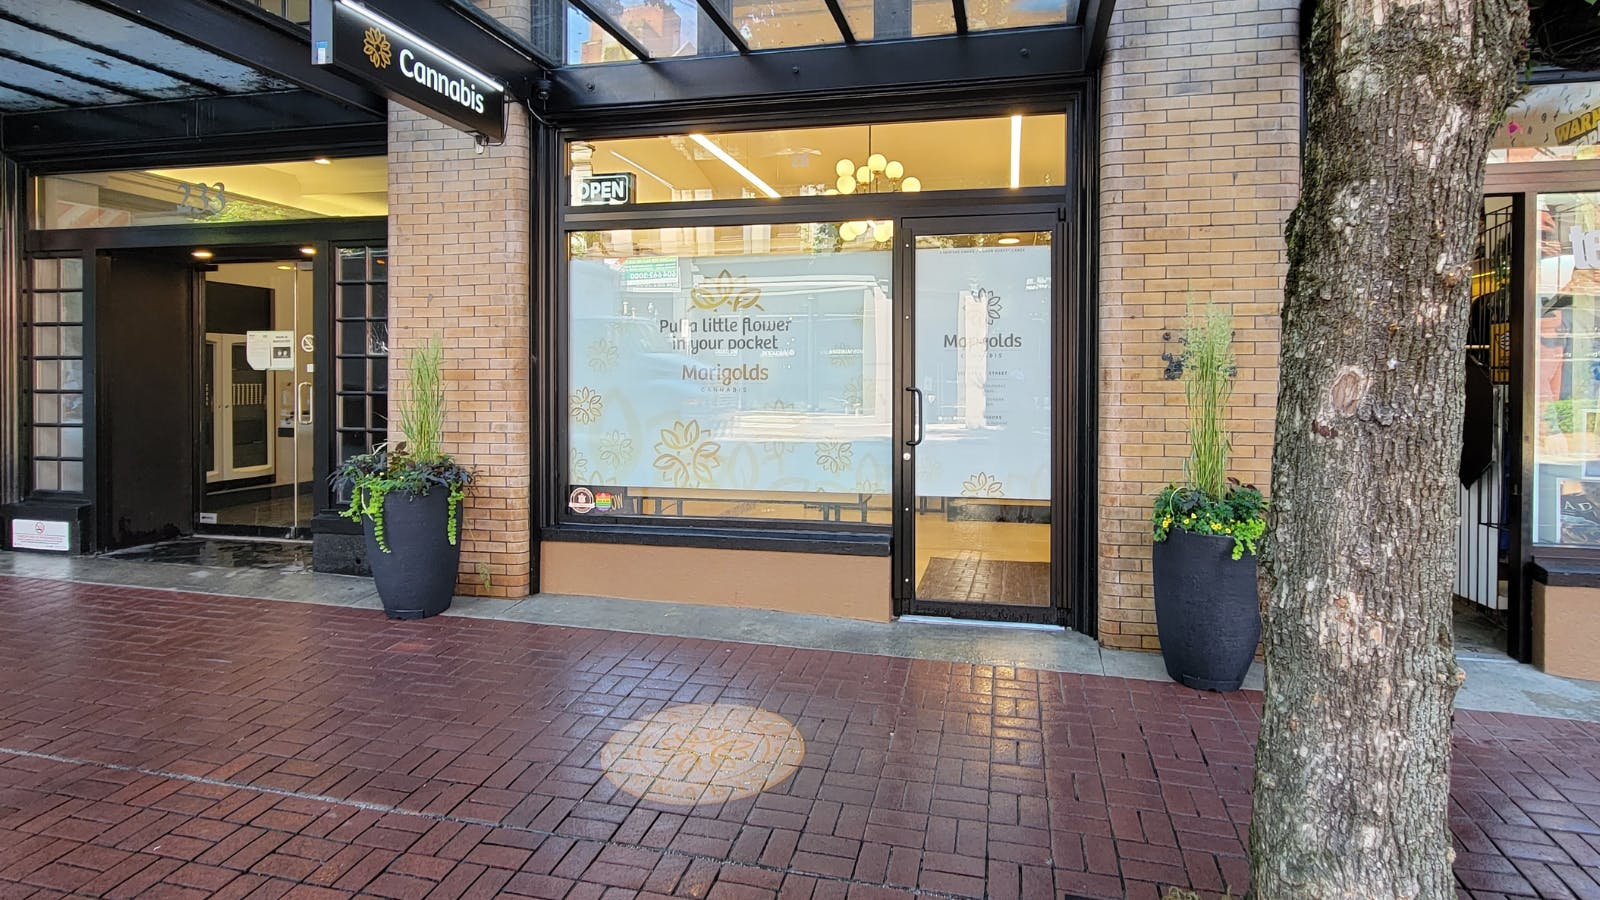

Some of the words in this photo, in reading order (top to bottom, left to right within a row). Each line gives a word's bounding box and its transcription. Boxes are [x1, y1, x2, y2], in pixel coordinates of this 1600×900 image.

[399, 49, 485, 114] Cannabis
[177, 182, 225, 216] 233
[580, 181, 624, 199] OPEN
[702, 318, 738, 333] little
[742, 317, 792, 336] flower
[672, 335, 686, 350] in
[691, 338, 724, 355] your
[728, 335, 779, 353] pocket
[682, 364, 769, 385] Marigolds
